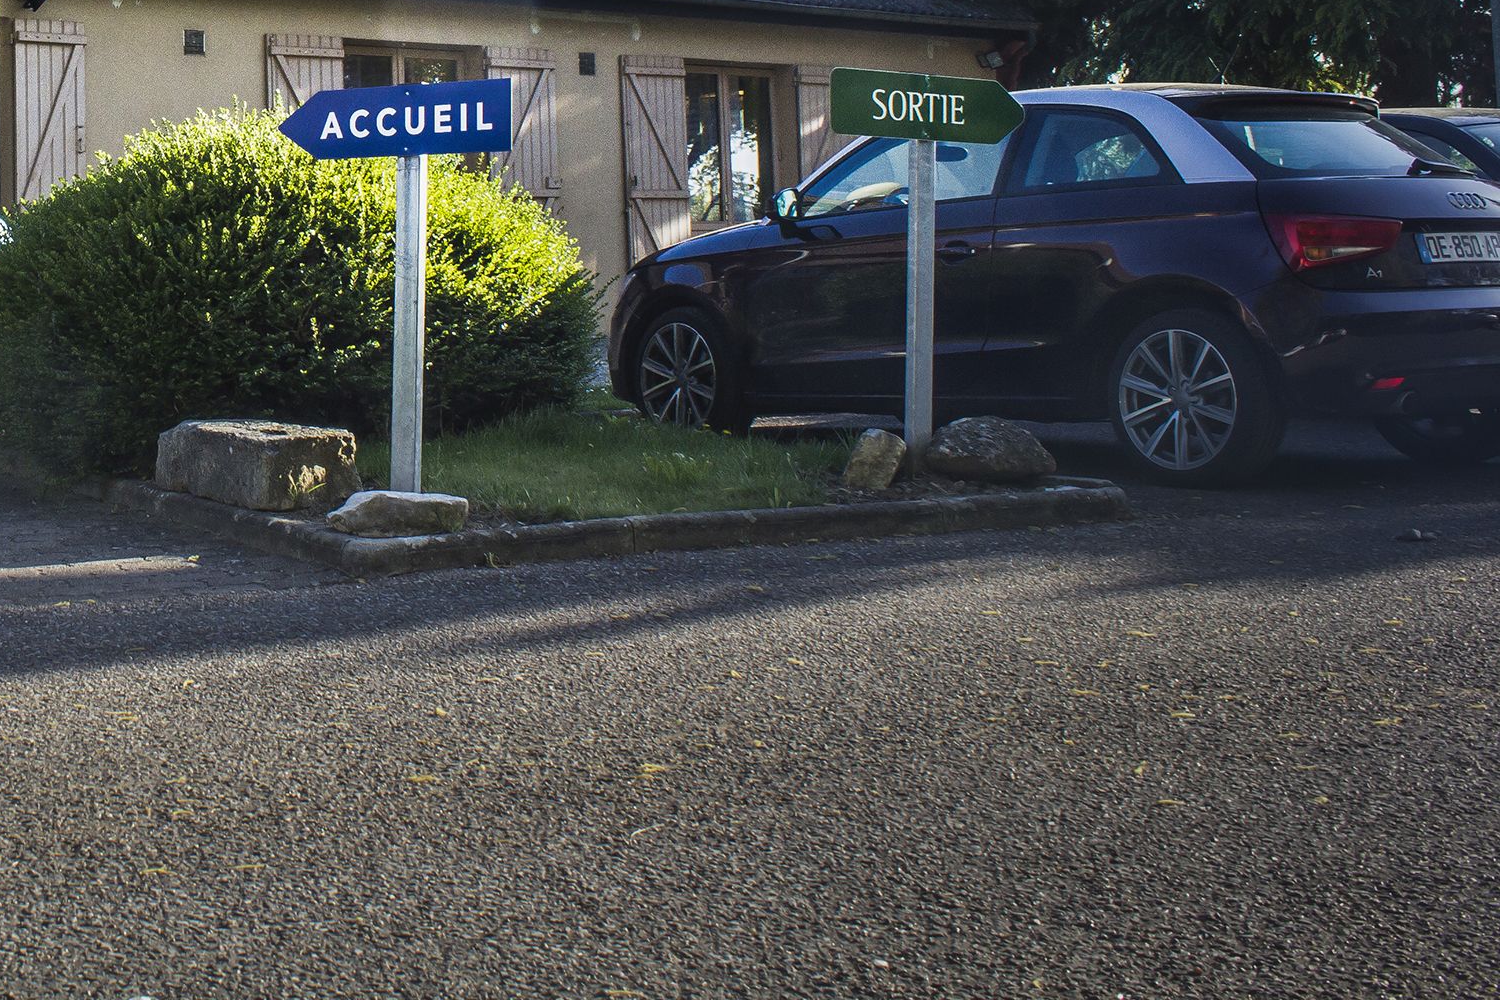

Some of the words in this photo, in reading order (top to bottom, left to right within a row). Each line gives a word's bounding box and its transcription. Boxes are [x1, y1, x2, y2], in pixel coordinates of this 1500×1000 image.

[319, 102, 493, 140] ACCUEIL
[872, 88, 965, 125] SORTIE
[1366, 266, 1383, 278] A1
